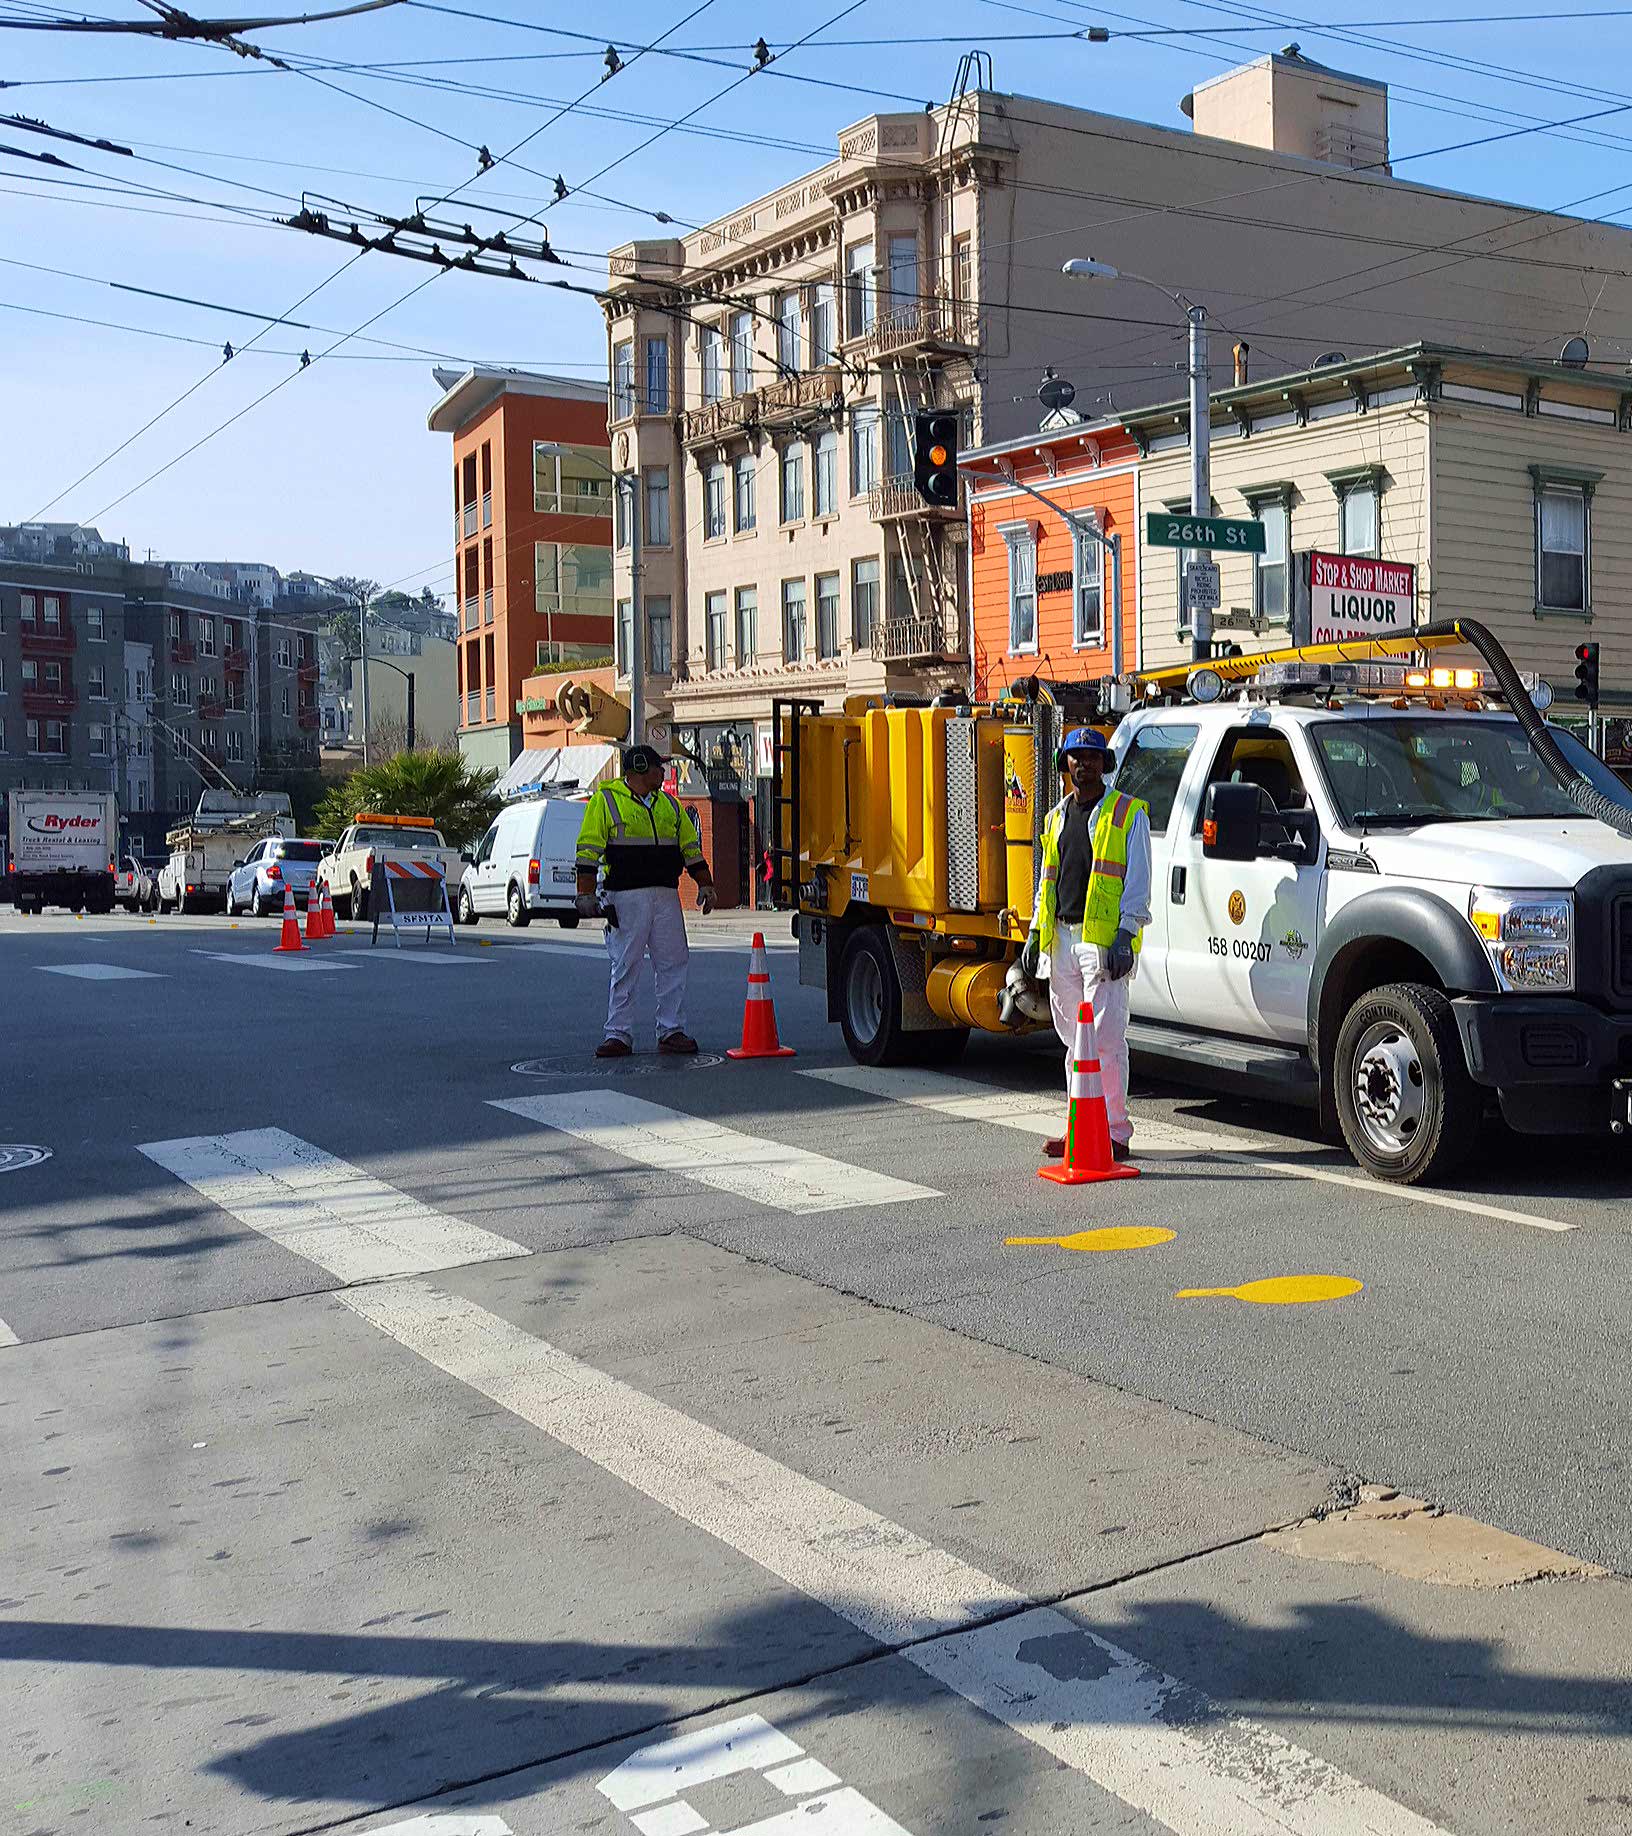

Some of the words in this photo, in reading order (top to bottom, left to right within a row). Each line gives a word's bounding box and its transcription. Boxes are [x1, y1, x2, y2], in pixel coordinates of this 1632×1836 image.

[1167, 522, 1216, 543] 26th
[1226, 527, 1248, 545] St
[1341, 564, 1348, 588] &
[1330, 593, 1397, 625] LIQUOR
[1249, 619, 1263, 629] ST
[44, 814, 101, 830] Ryder
[74, 837, 101, 846] Leasing
[1207, 936, 1228, 957] 158
[1232, 939, 1273, 963] 00207
